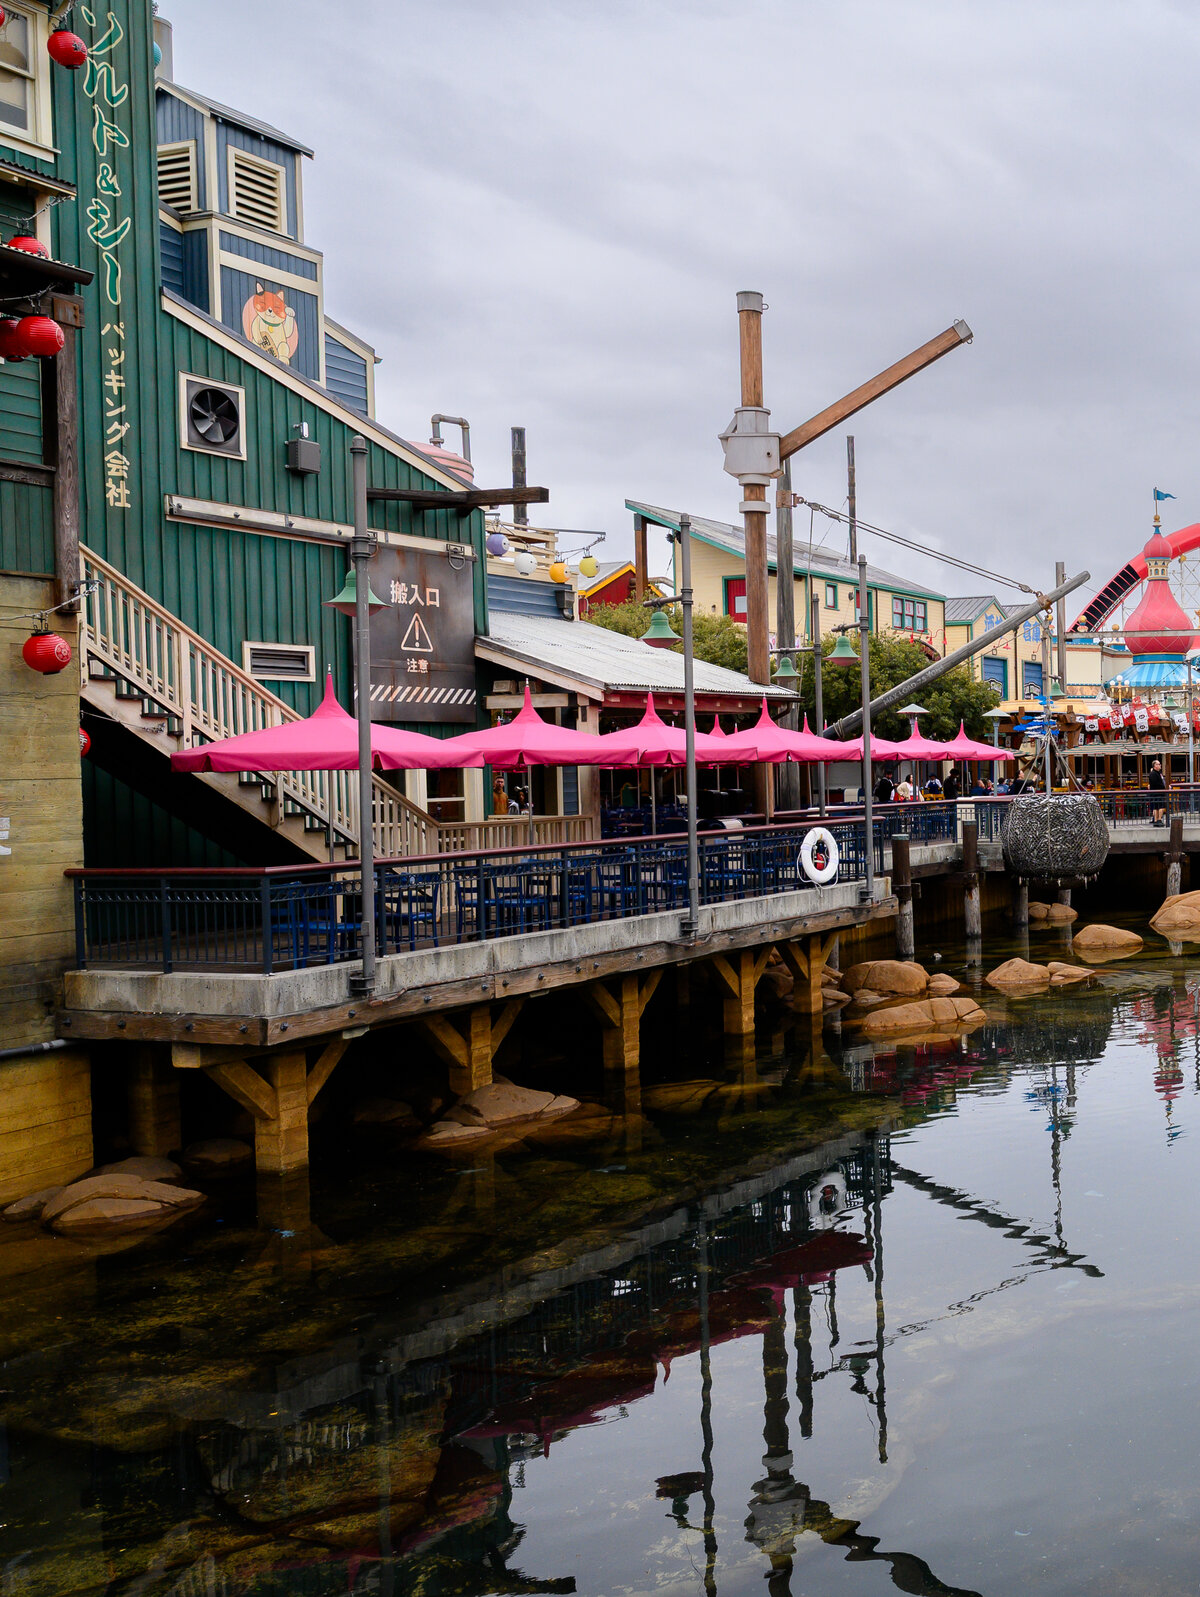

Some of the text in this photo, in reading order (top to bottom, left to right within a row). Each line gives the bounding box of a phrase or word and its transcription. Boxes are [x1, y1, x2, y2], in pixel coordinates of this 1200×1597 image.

[101, 322, 131, 508] パッキング会社
[390, 580, 440, 607] 搬入口
[406, 658, 429, 673] 注意
